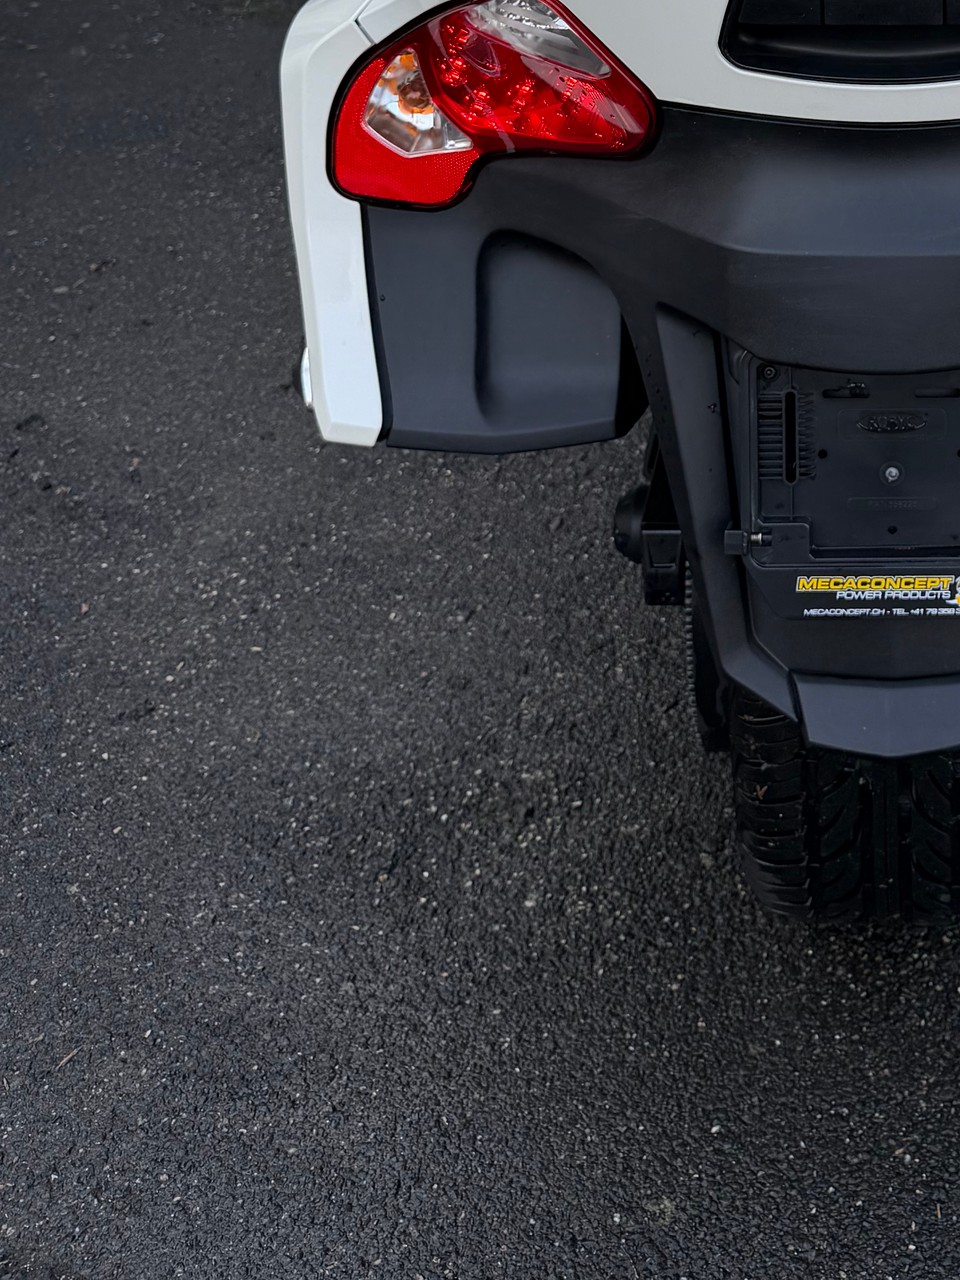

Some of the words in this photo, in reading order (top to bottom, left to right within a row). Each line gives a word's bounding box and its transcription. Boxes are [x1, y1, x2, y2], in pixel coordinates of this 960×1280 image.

[797, 576, 954, 591] MECACONCEPT
[836, 590, 882, 600] POWER
[884, 590, 951, 600] PRODUCTS
[803, 608, 885, 616] MECACONCEPT.CH
